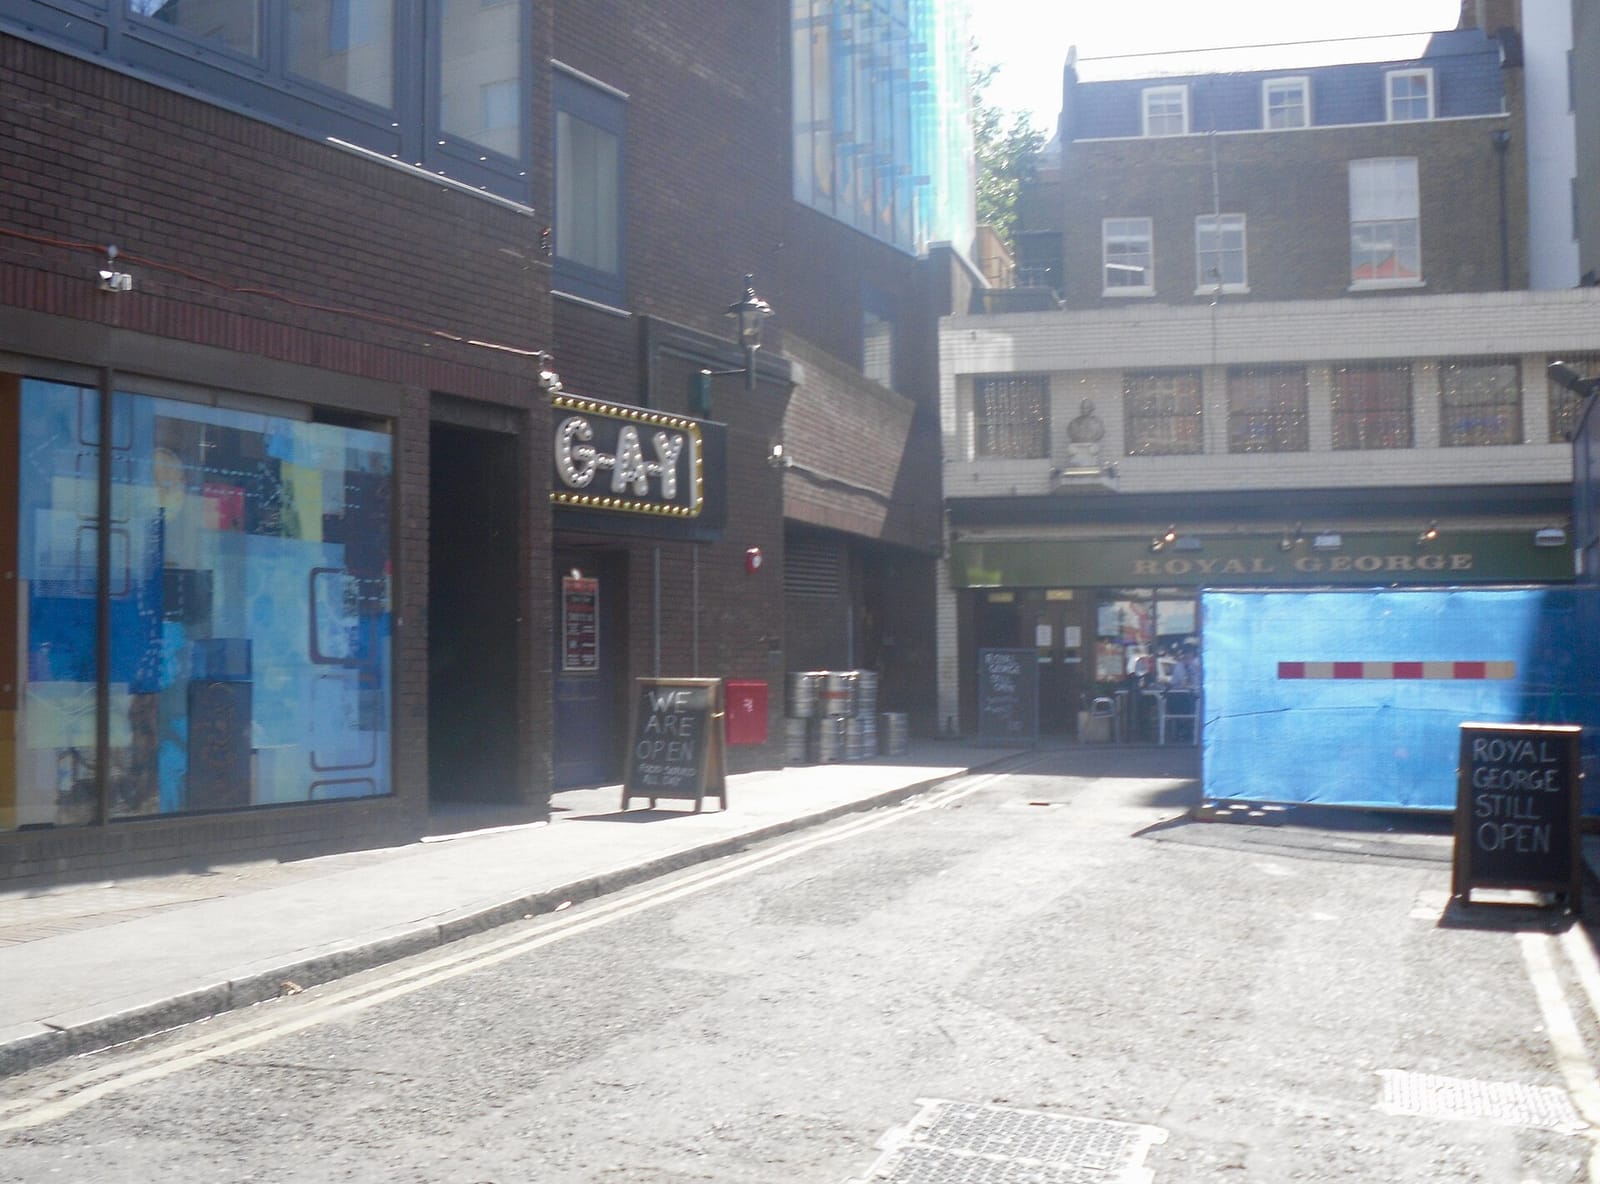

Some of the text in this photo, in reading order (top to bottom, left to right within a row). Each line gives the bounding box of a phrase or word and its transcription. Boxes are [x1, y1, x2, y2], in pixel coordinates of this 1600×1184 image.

[555, 416, 683, 499] G-A-Y
[1132, 552, 1474, 576] ROYAL GEORGE
[647, 690, 693, 714] WE
[643, 714, 696, 737] ARE
[637, 739, 694, 761] OPEN
[1474, 738, 1556, 764] ROYAL
[1474, 767, 1560, 792] GEORGE
[1475, 794, 1541, 821] STILL
[1478, 822, 1551, 853] OPEN
